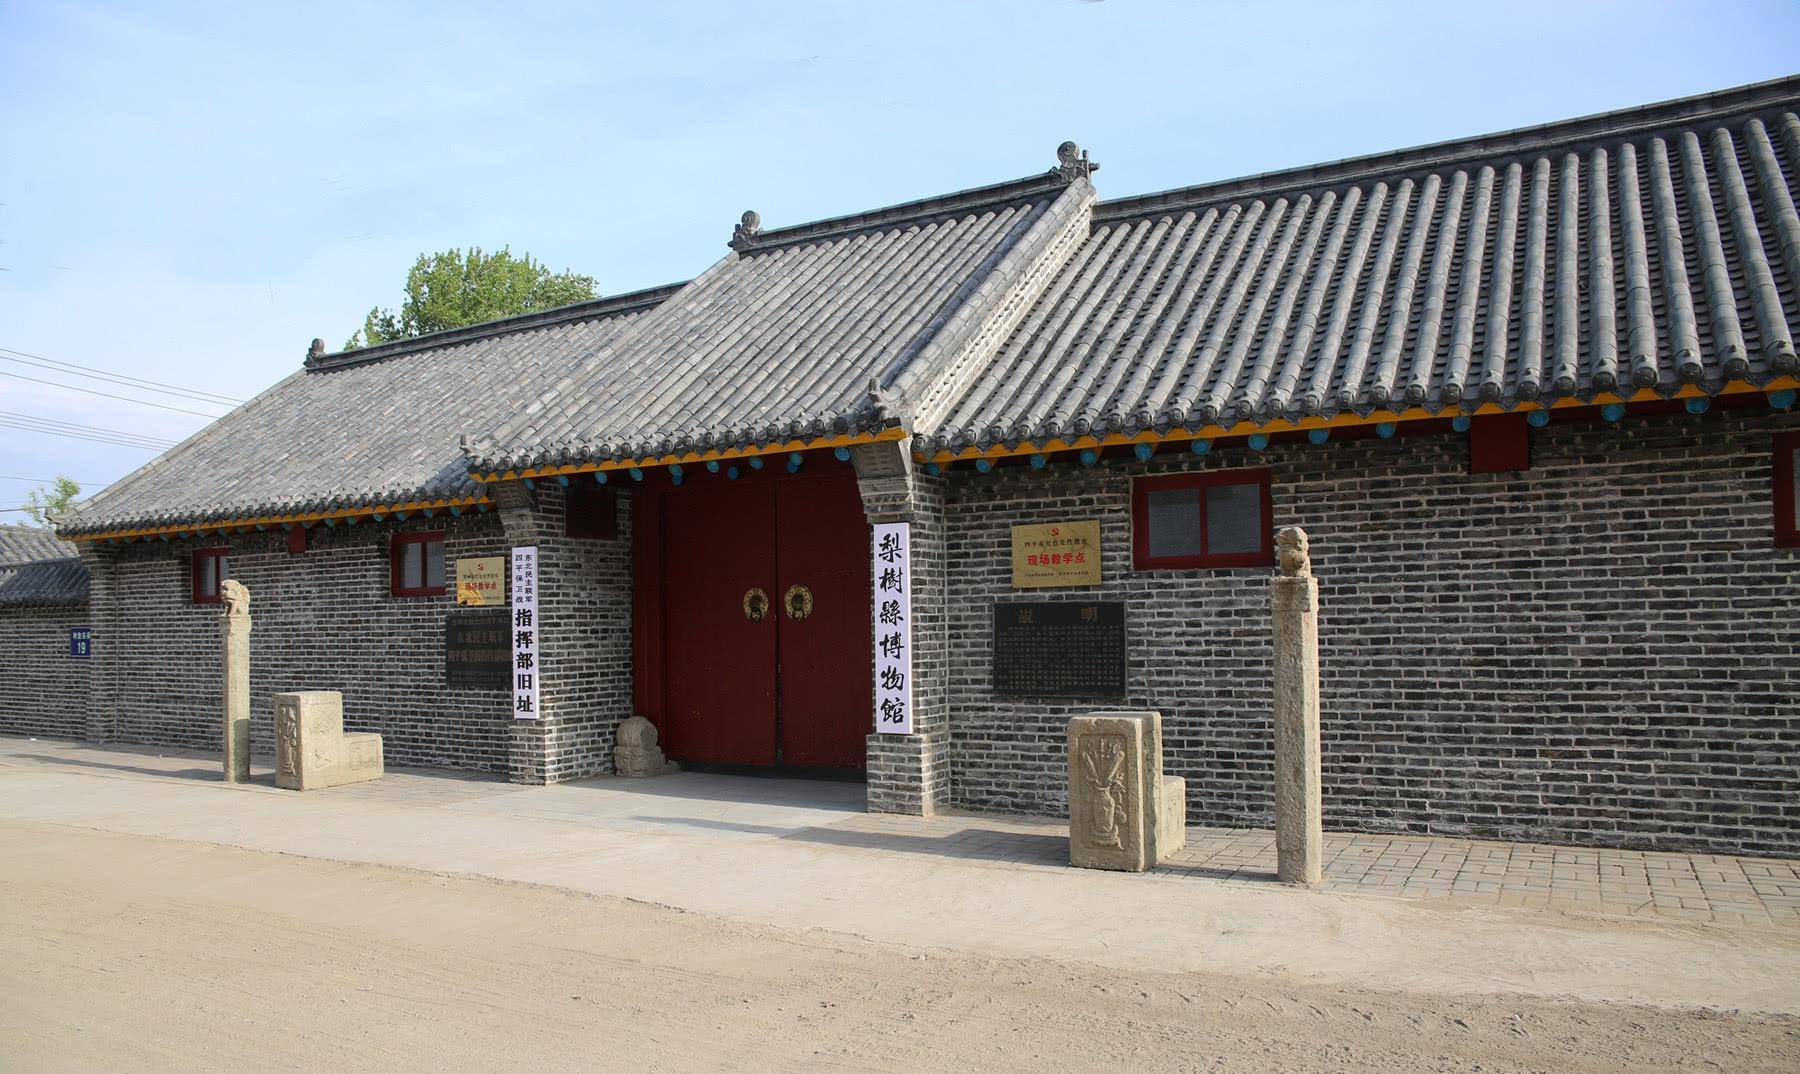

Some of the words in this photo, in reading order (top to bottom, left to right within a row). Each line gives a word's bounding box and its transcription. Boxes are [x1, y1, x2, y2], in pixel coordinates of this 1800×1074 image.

[515, 554, 524, 603] 四平保卫战
[525, 554, 533, 603] 东北民主联军
[1027, 552, 1086, 566] 现场教学点
[77, 641, 86, 654] 19
[878, 532, 905, 725] 梨樹縣博物館
[515, 608, 534, 713] 指挥部旧址
